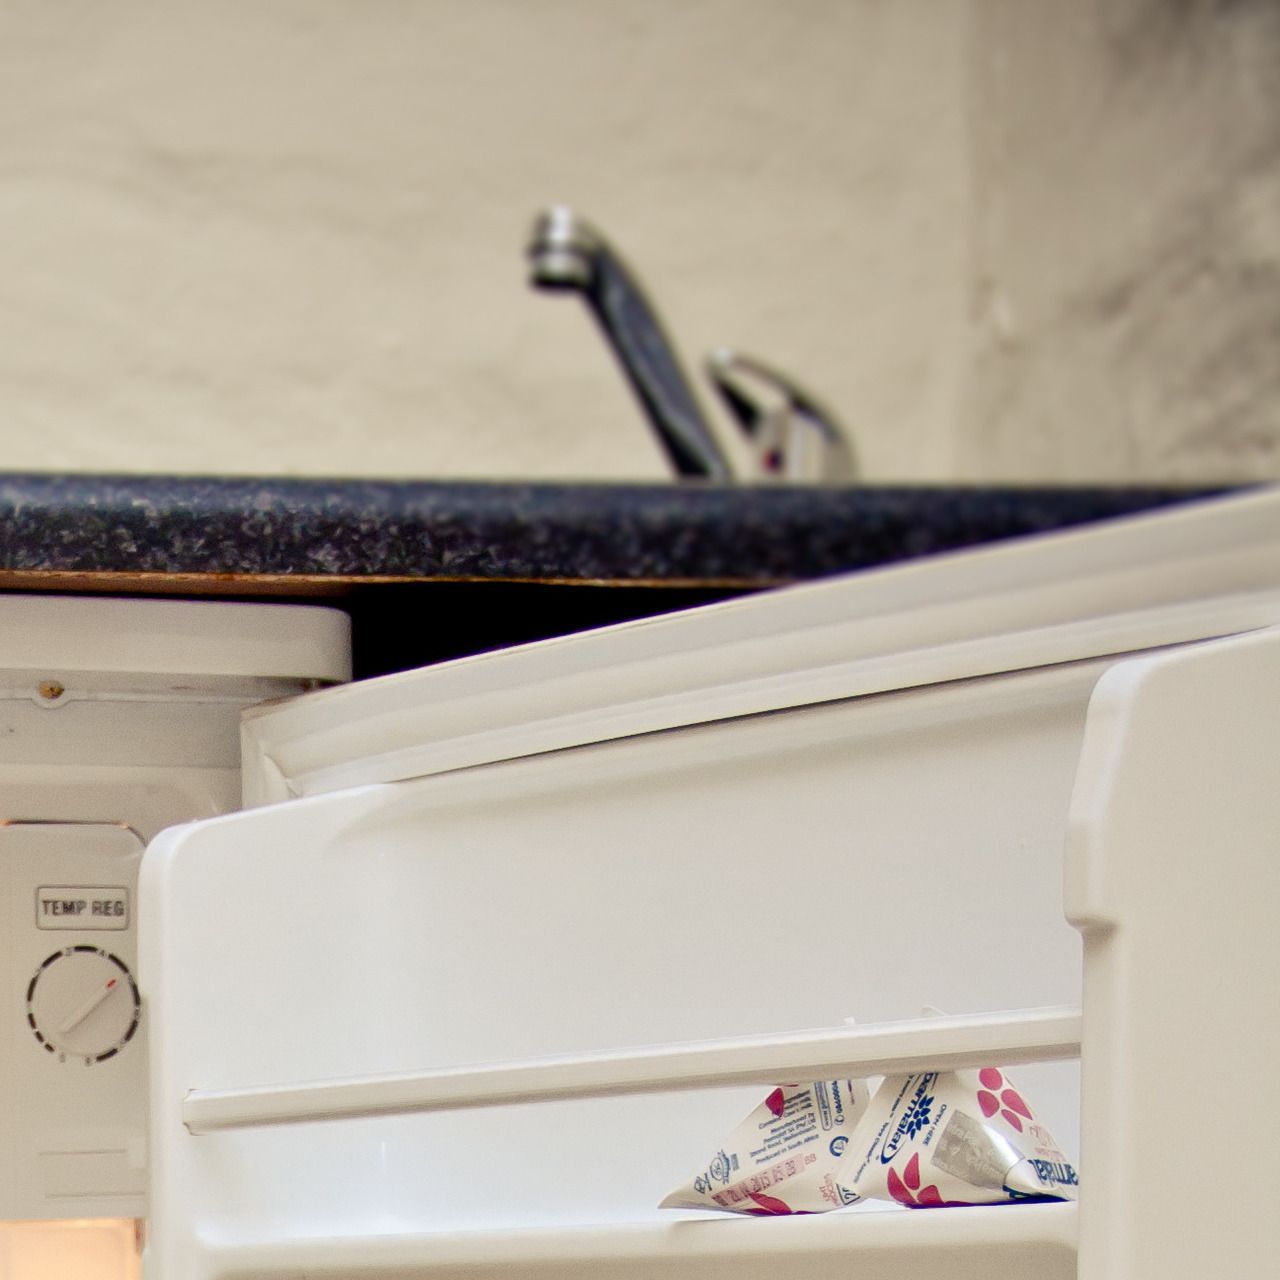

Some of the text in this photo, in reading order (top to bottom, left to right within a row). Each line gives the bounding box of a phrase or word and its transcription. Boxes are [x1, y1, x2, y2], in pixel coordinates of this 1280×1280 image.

[42, 900, 124, 916] TEMP REG
[886, 1072, 934, 1151] parmalat
[932, 1103, 948, 1126] OPEN
